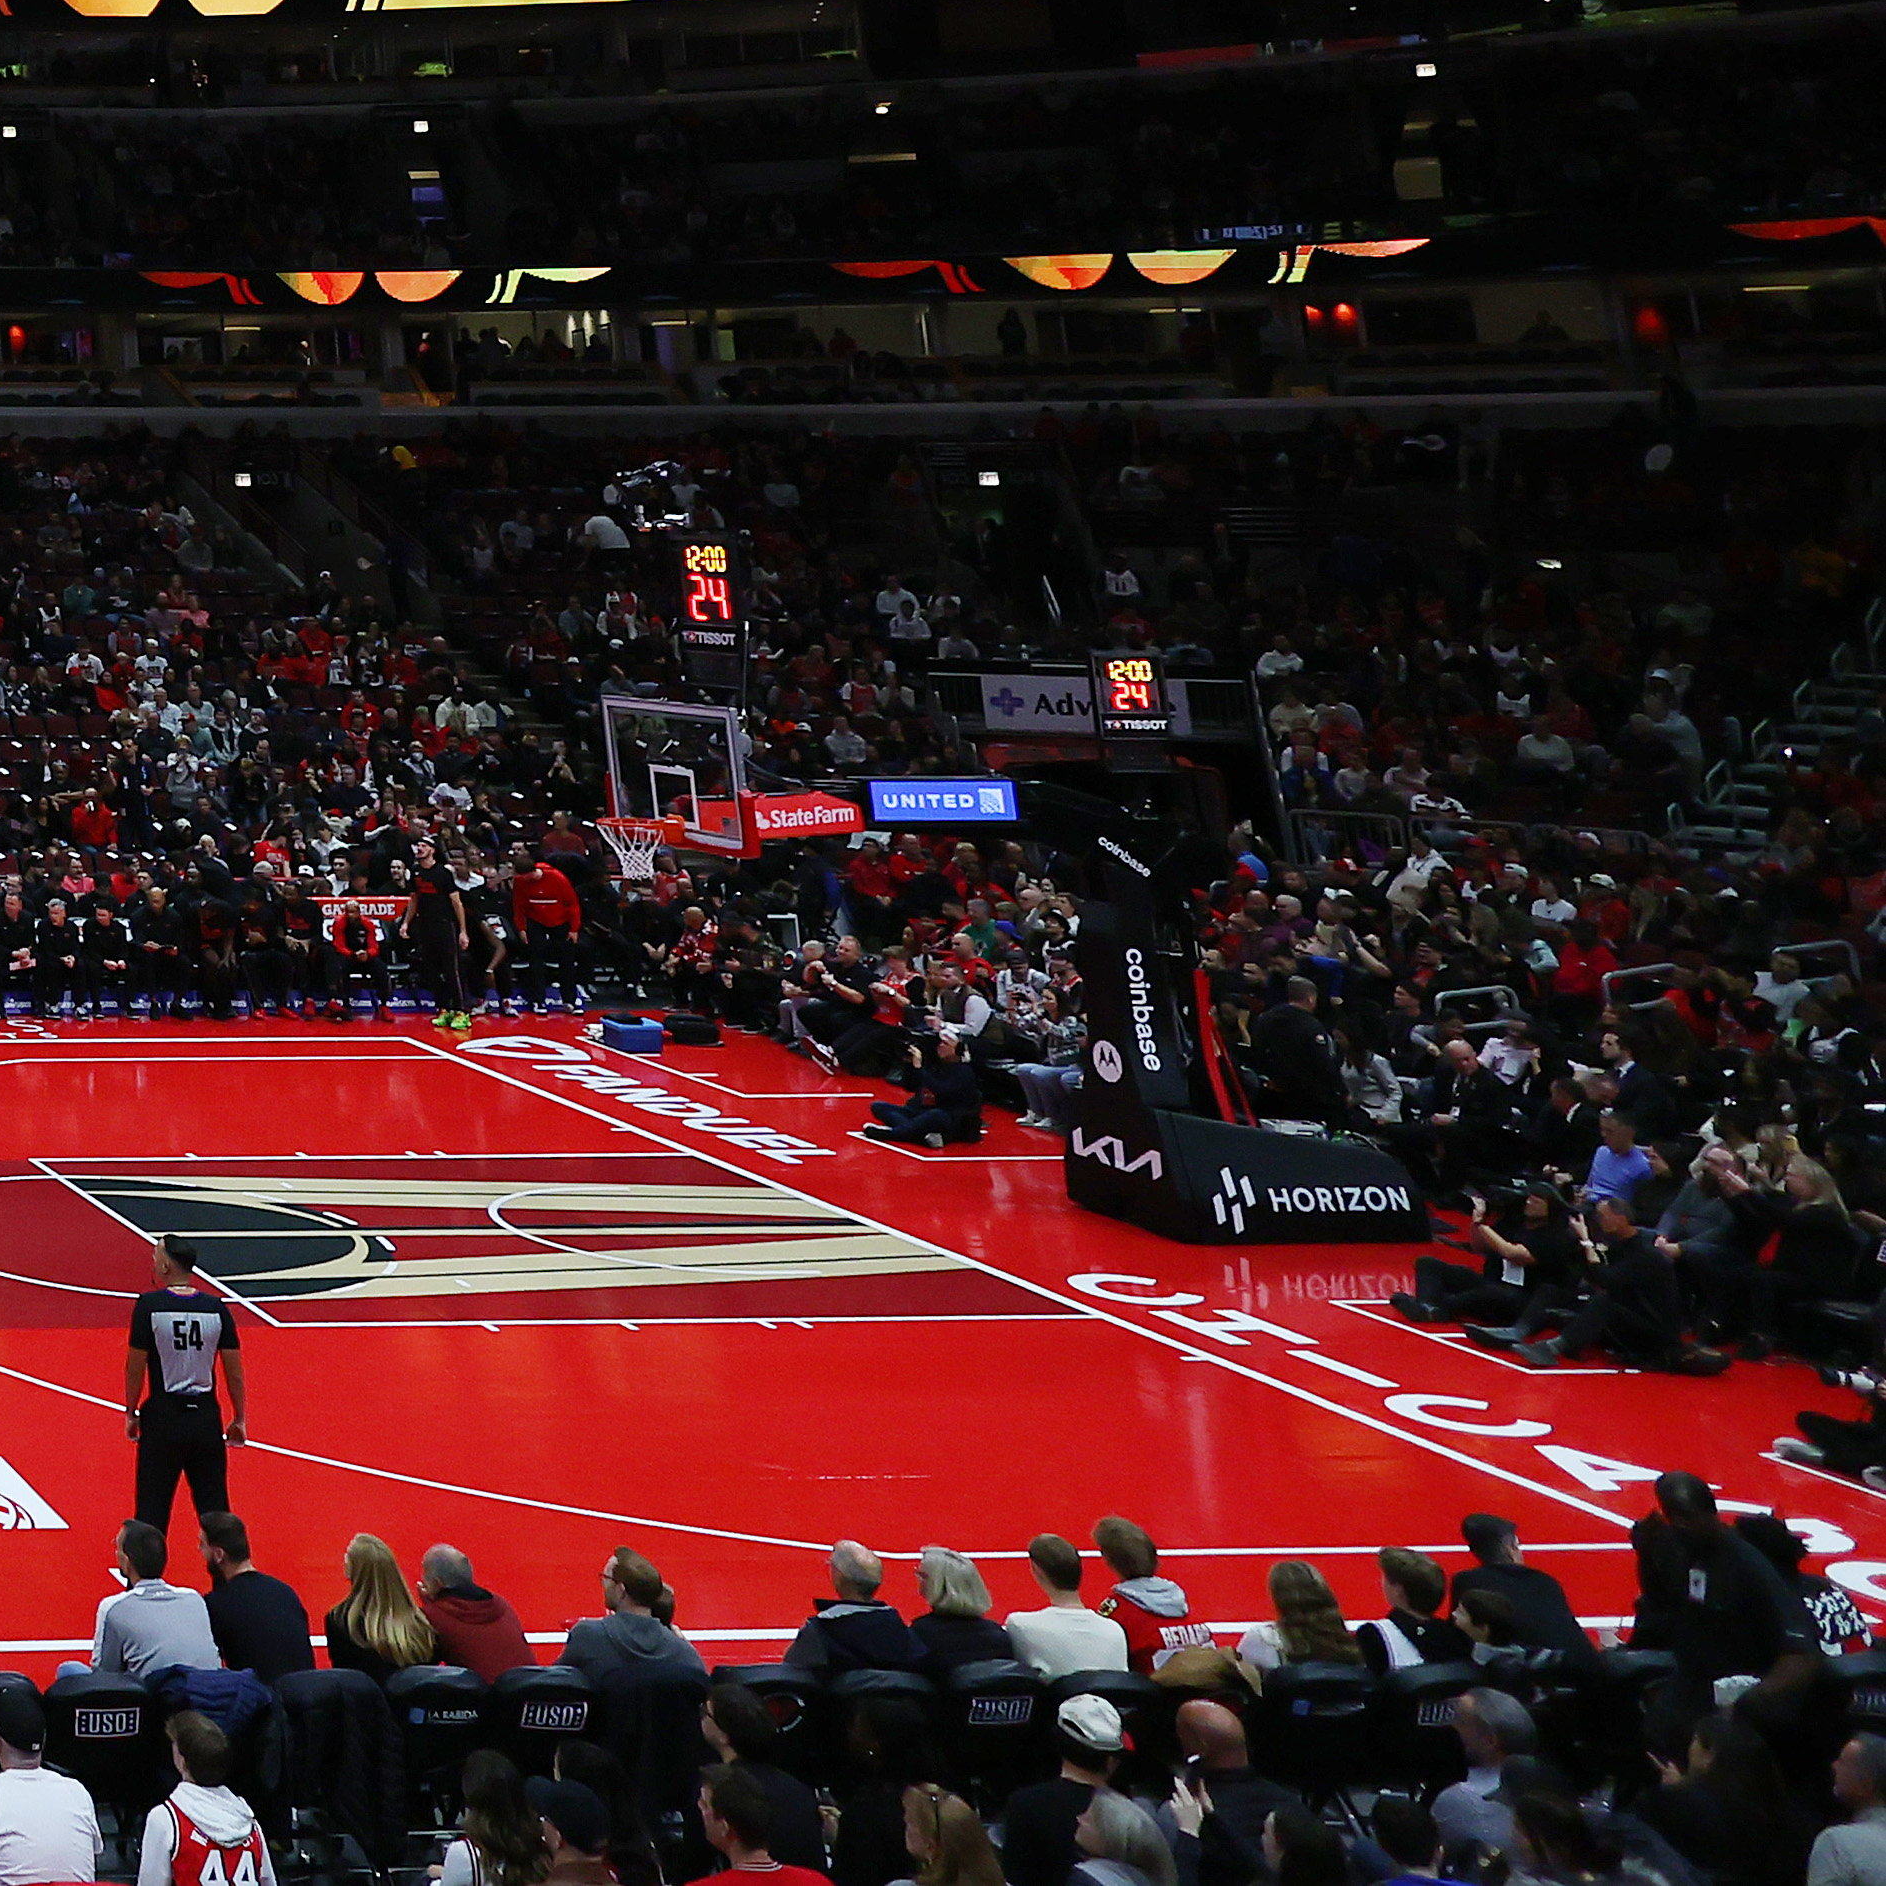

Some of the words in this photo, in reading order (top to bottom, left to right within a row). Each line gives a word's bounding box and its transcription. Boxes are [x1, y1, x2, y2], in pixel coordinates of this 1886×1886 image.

[684, 545, 726, 573] 12:00
[687, 574, 732, 622] 24
[697, 631, 736, 647] TISSOT
[1106, 660, 1153, 682] 12:00
[1111, 682, 1151, 711] 24
[1123, 719, 1169, 731] TISSOT
[882, 790, 975, 813] UNITED
[770, 804, 856, 830] StateFarm
[1097, 834, 1152, 878] coinbase
[1125, 947, 1162, 1074] coinbase
[531, 1063, 837, 1165] FANDUEL
[1267, 1184, 1412, 1215] HORIZON
[172, 1321, 205, 1354] 54
[88, 1712, 127, 1734] USO
[535, 1705, 573, 1726] USO
[197, 1848, 263, 1886] 44
